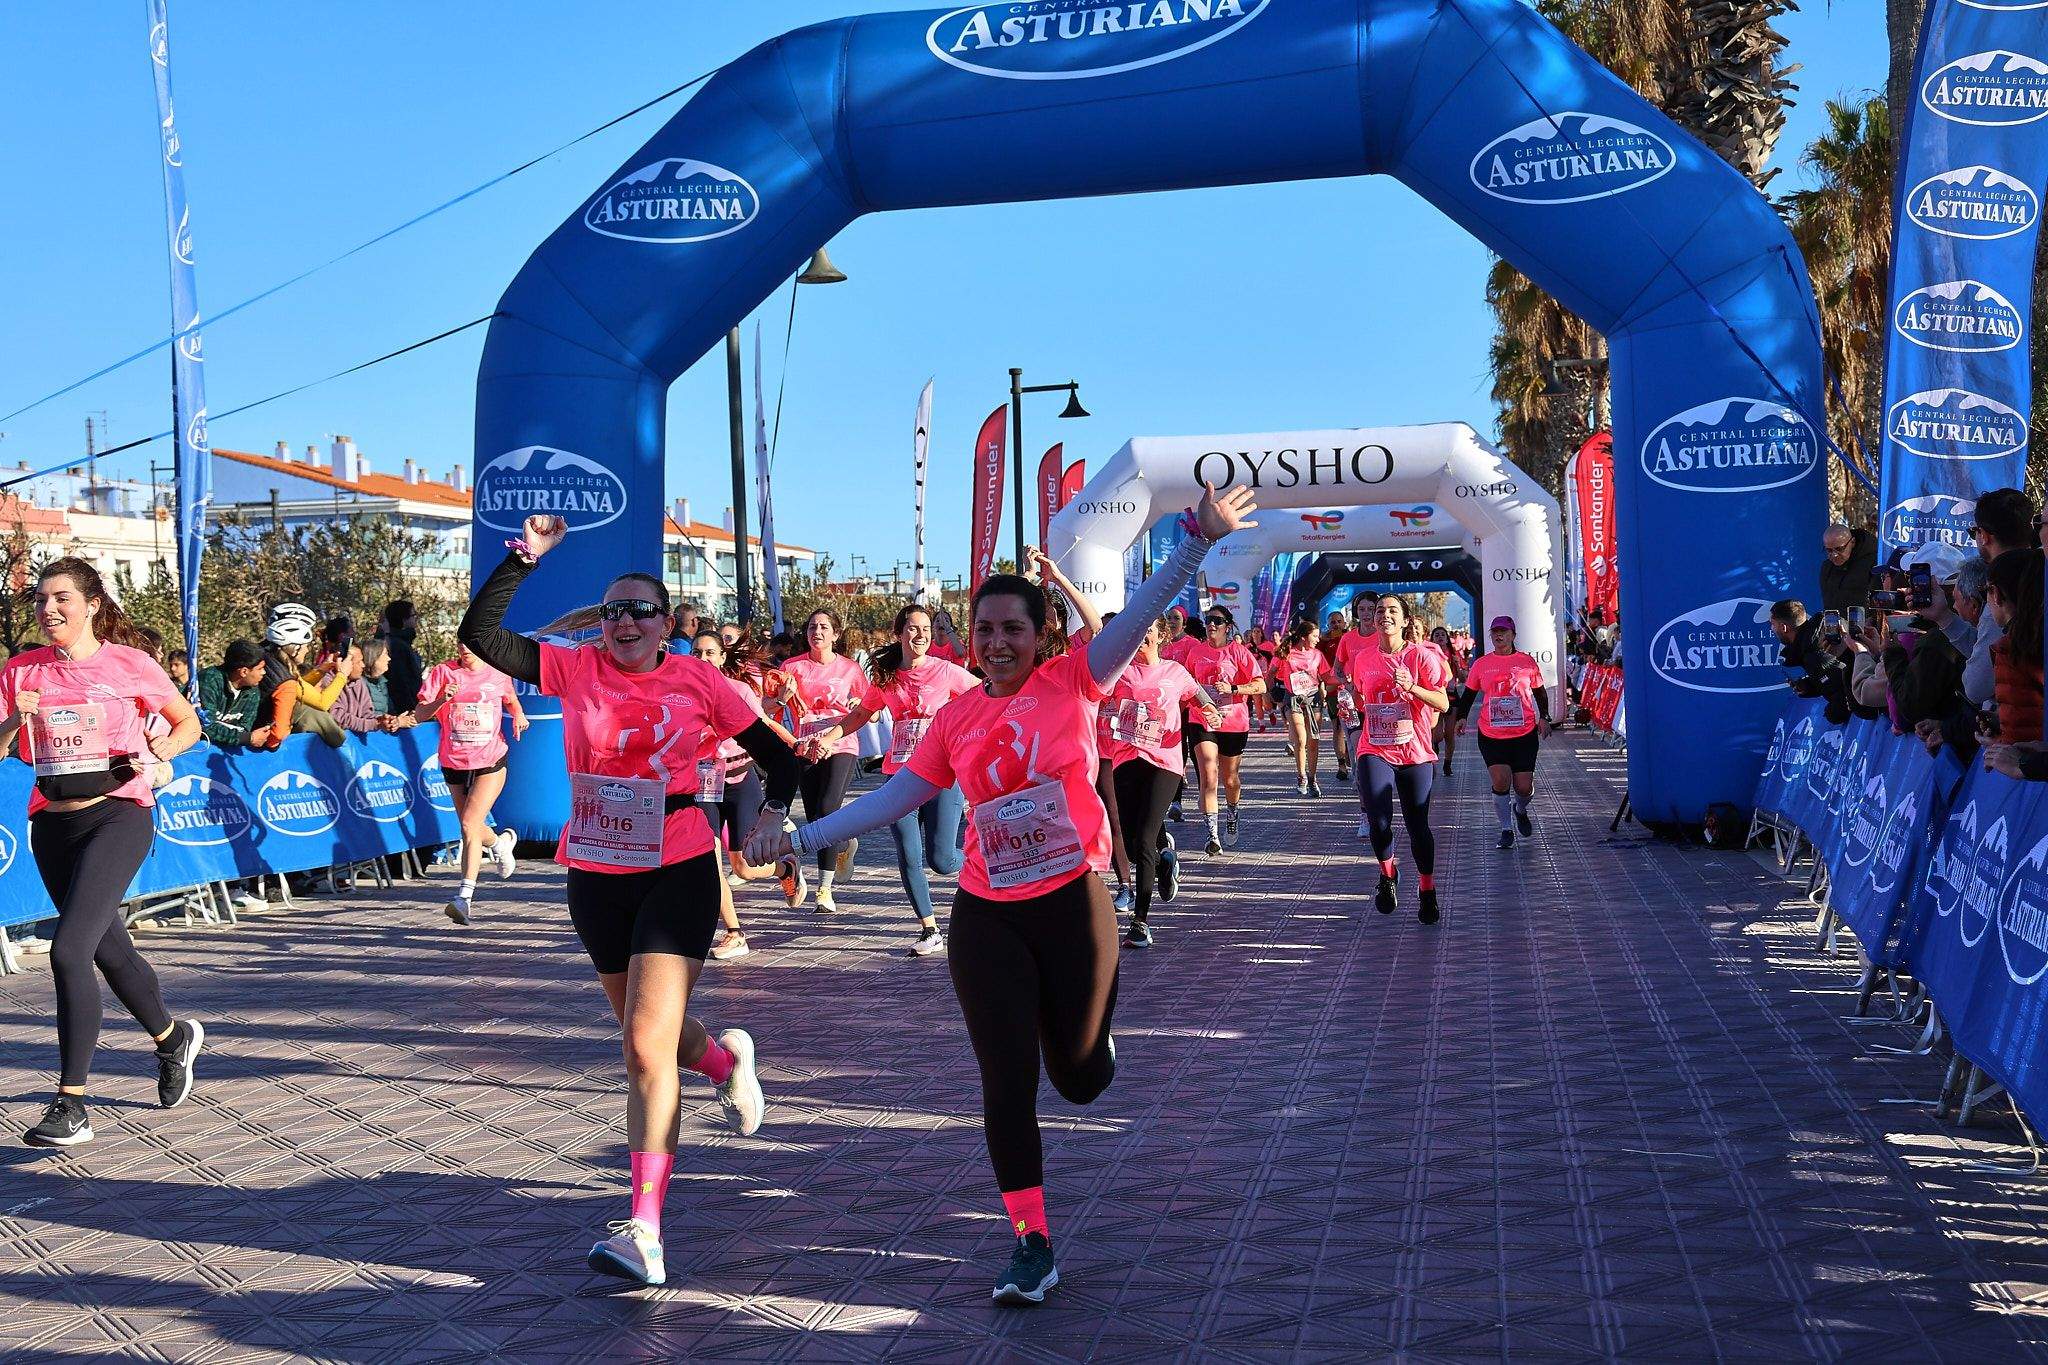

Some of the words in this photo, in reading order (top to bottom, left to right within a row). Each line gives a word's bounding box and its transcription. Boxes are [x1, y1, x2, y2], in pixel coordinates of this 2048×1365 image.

[949, 0, 1245, 52] ASTURIANA
[1956, 75, 2001, 84] CENTRAL
[1514, 141, 1581, 159] CENTRAL
[1588, 137, 1652, 149] LECHERA
[1487, 148, 1665, 188] ASTURIANA
[621, 185, 675, 198] CENTRAL
[679, 185, 739, 194] LECHERA
[1940, 189, 1981, 199] CENTRAL
[1985, 191, 2027, 202] LECHERA
[593, 195, 746, 224] ASTURIANA
[1915, 189, 2027, 225] ASTURIANA
[1923, 302, 1973, 312] CENTRAL
[1977, 305, 2012, 318] LECHERA
[1902, 302, 2017, 340] ASTURIANA
[1911, 409, 1957, 420] CENTRAL
[1962, 413, 2014, 425] LECHERA
[1680, 430, 1744, 443] CENTRAL
[1751, 428, 1806, 438] LECHERA
[1893, 409, 2018, 447] ASTURIANA
[1652, 437, 1811, 473] ASTURIANA
[1193, 444, 1394, 491] OYSHO
[494, 476, 545, 486] CENTRAL
[550, 476, 610, 487] LECHERA
[479, 480, 615, 513] ASTURIANA
[981, 442, 998, 550] Santander
[1455, 482, 1517, 499] OYSHO
[1078, 501, 1136, 515] OYSHO
[1591, 460, 1604, 553] Santander
[1903, 515, 1949, 525] CENTRAL
[1301, 533, 1345, 541] TotalEnergies
[1390, 530, 1435, 538] TotalEnergies
[1887, 514, 1978, 548] ASTURIA
[1344, 560, 1443, 573] VOLVO
[1492, 566, 1550, 582] OYSHO
[1073, 581, 1107, 594] SHO
[1688, 630, 1752, 642] CENTRAL
[1661, 635, 1787, 670] ASTURIA
[463, 719, 481, 727] 016
[1132, 720, 1151, 731] 016
[53, 735, 83, 748] 016
[600, 788, 632, 799] ASTURIANA
[265, 796, 337, 822] ASTURIANA
[1000, 803, 1034, 819] ASTURIANA
[159, 803, 248, 832] ASTURIANA
[599, 814, 633, 832] 016
[605, 833, 621, 841] 1332
[1009, 828, 1048, 850] 016
[576, 847, 604, 857] OYSHO
[620, 854, 651, 862] Santander
[1021, 848, 1040, 859] 1333
[1045, 858, 1075, 872] Santander
[999, 871, 1029, 884] OYSHO
